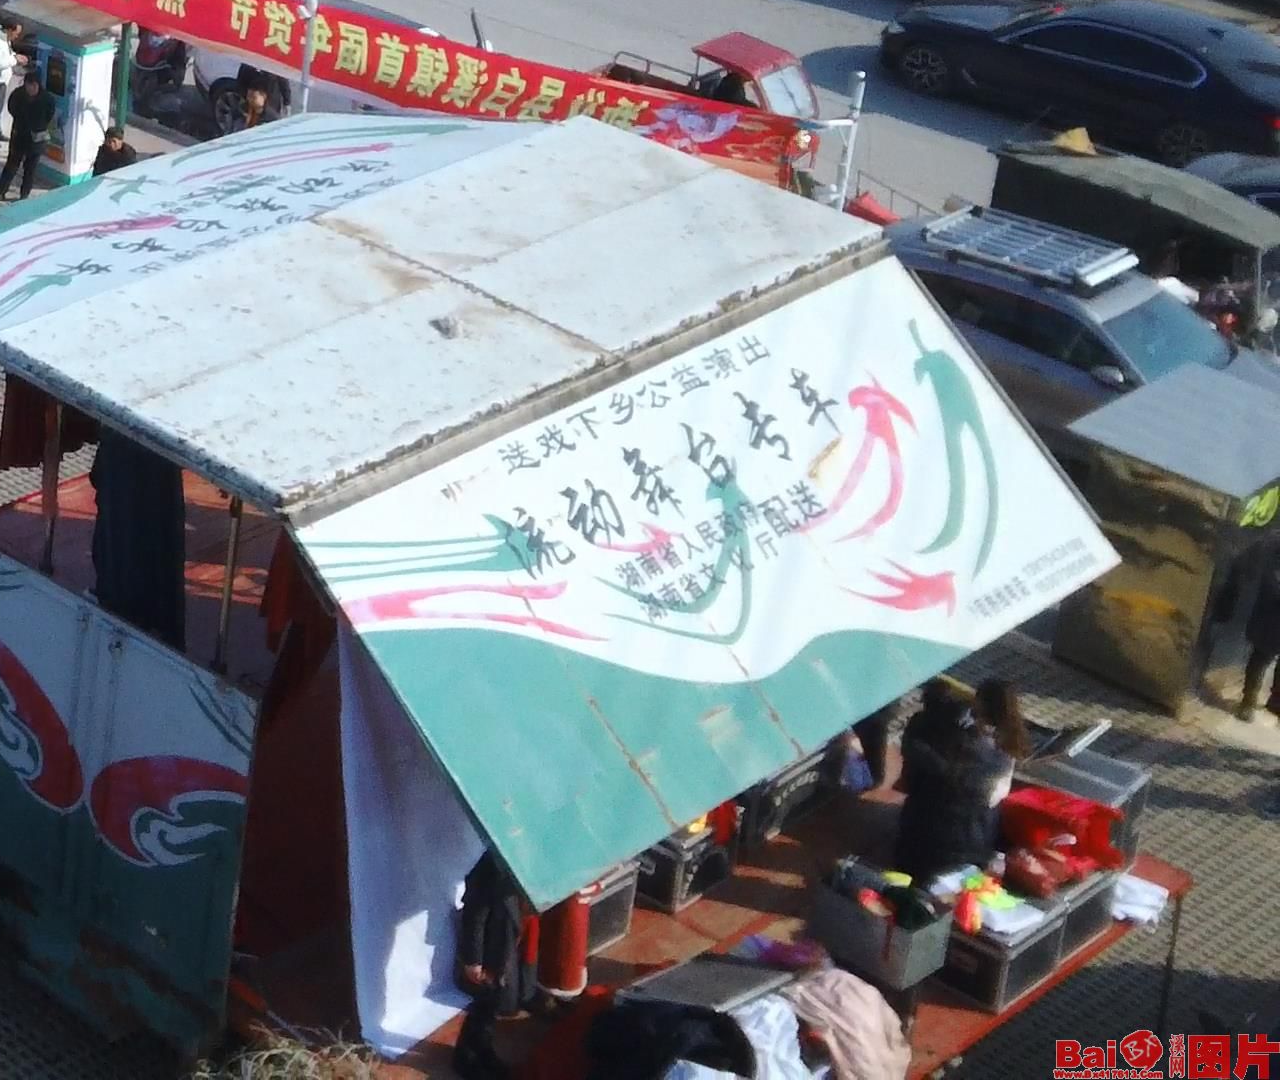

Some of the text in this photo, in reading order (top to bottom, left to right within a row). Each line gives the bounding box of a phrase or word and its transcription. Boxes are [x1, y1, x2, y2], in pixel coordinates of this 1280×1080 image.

[497, 334, 770, 475] 送戏下乡公益演出
[504, 367, 842, 581] 流动舞台专车
[757, 480, 828, 541] 配送
